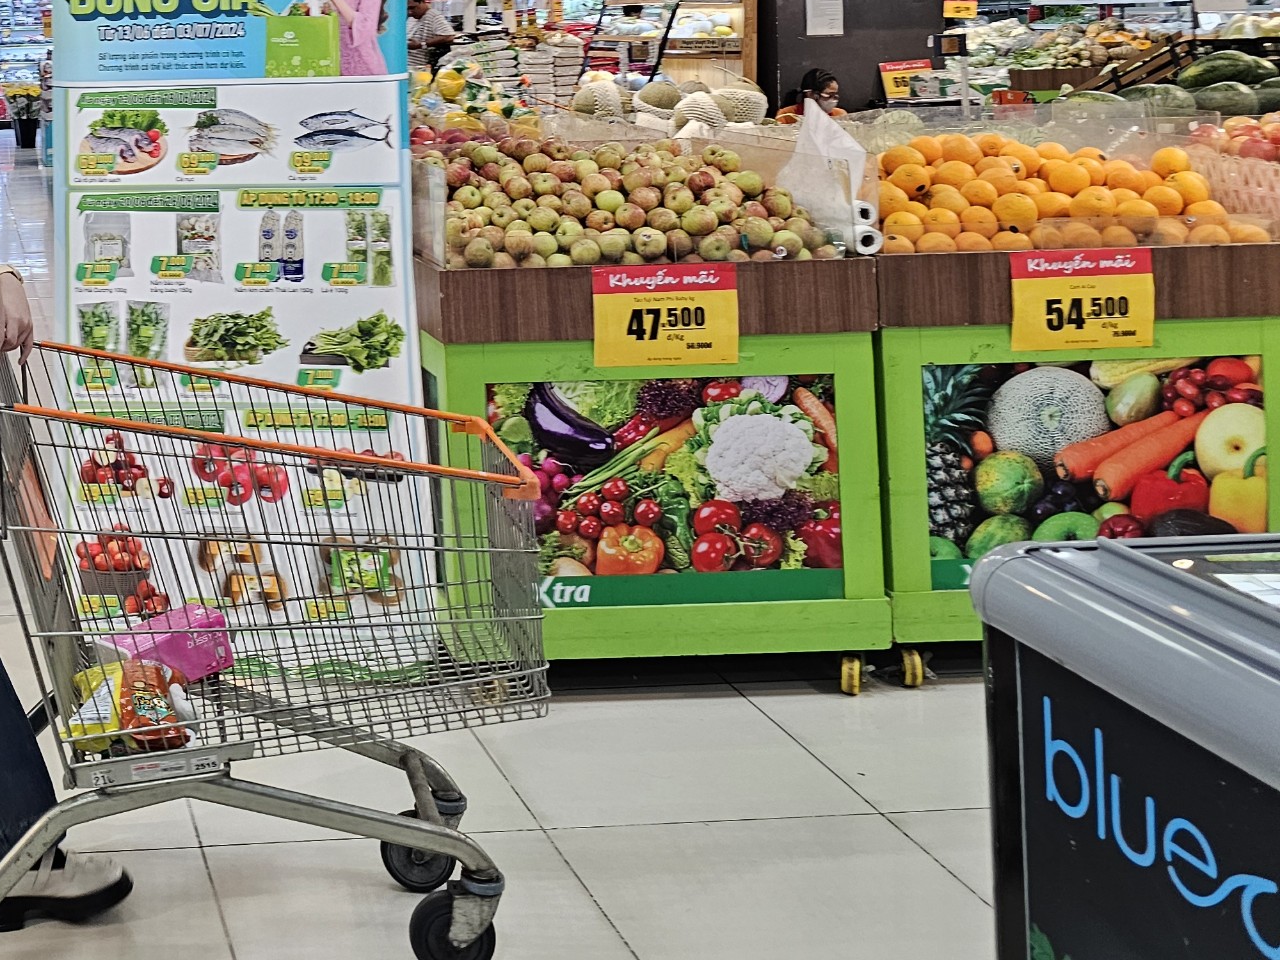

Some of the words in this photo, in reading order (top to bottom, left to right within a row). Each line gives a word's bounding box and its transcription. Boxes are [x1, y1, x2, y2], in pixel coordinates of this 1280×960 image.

[1027, 253, 1097, 273] Khuyến
[1099, 254, 1136, 268] mãi
[609, 269, 681, 289] Khuyến
[683, 270, 720, 284] mãi
[627, 306, 706, 341] 47.500
[1045, 296, 1129, 332] 54.500
[194, 760, 218, 772] 2515
